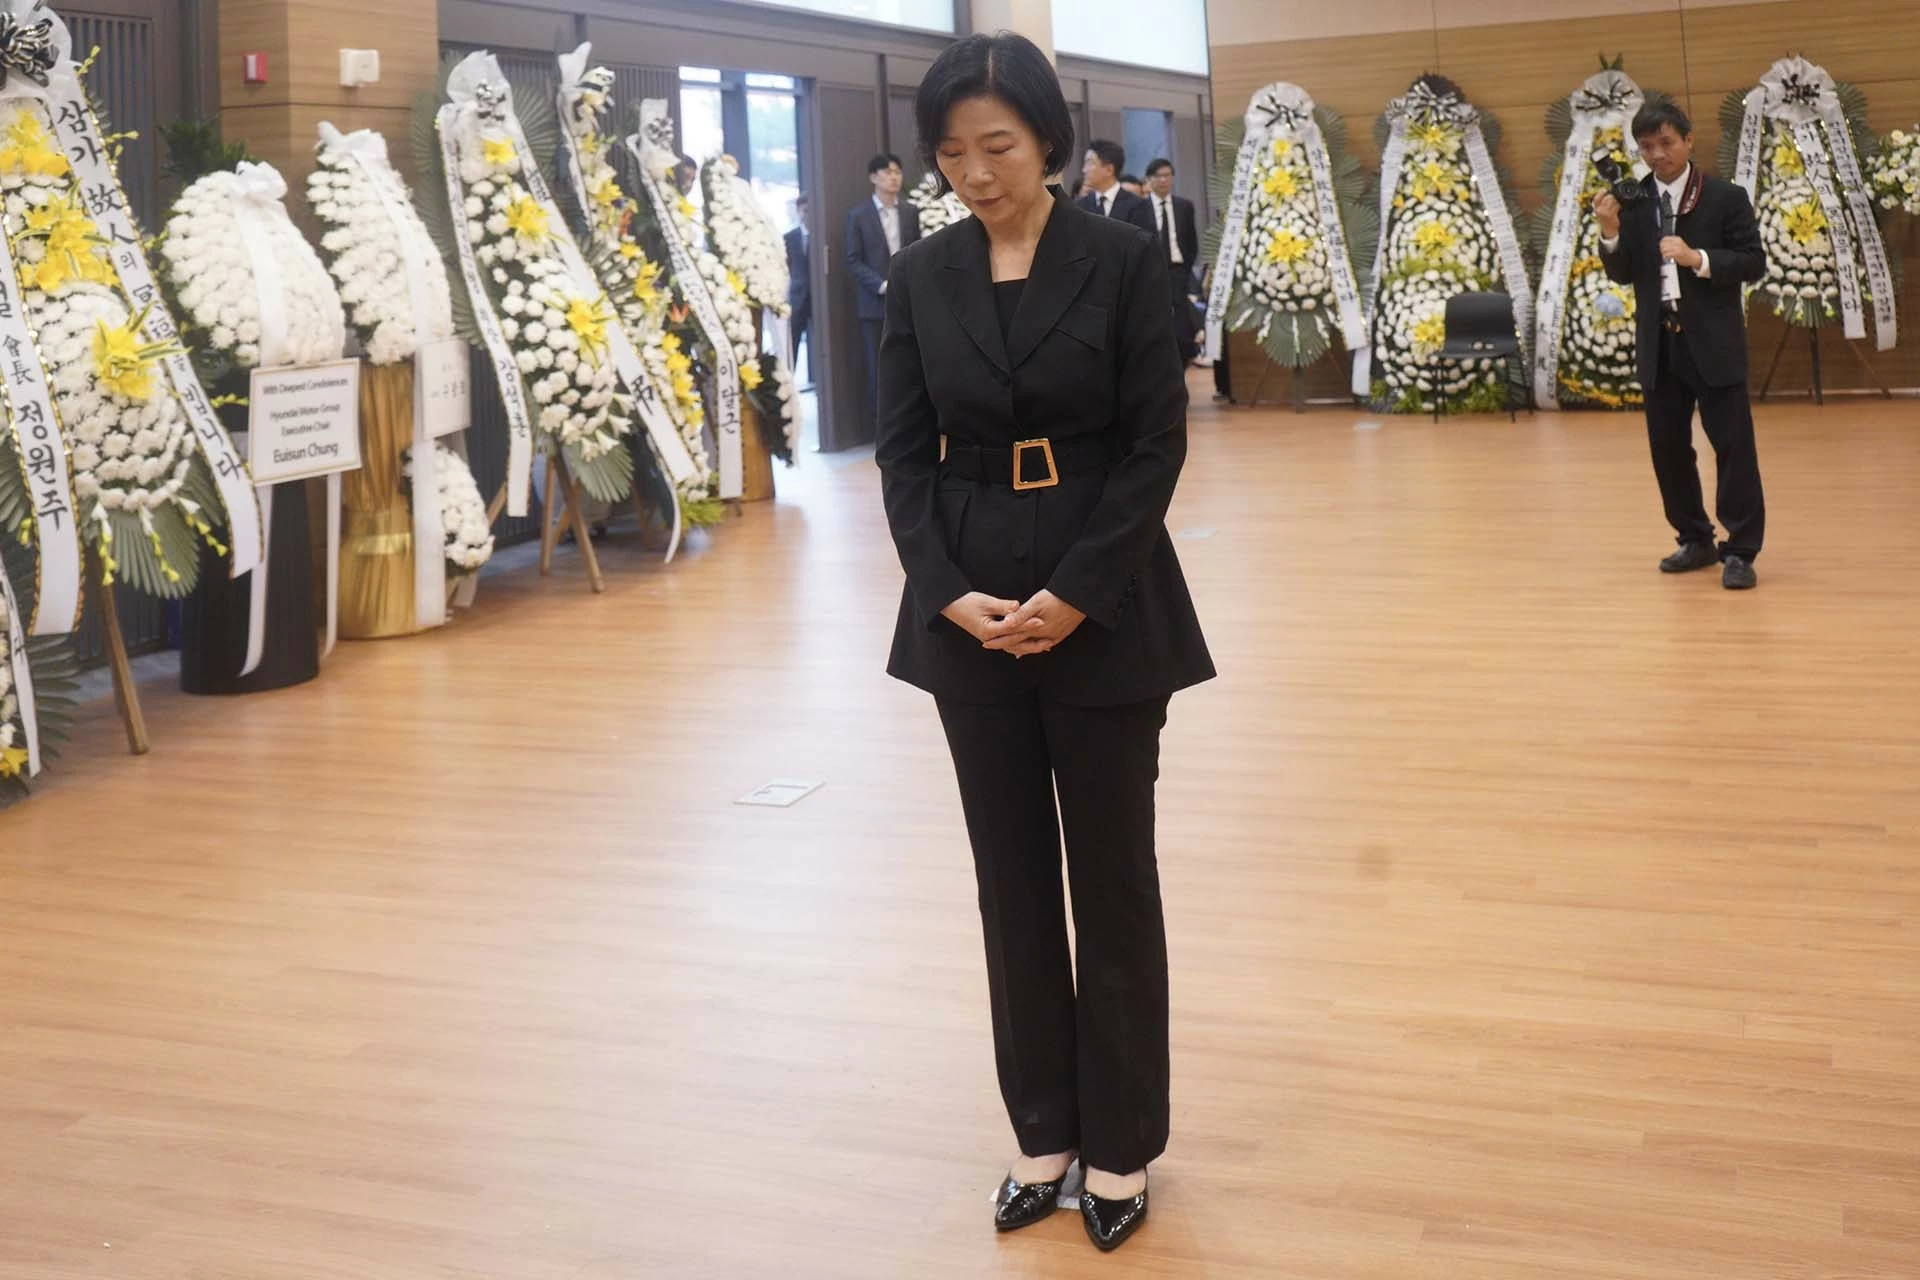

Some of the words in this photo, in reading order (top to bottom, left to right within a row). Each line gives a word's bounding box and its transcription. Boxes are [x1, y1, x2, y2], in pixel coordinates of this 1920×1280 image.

[57, 100, 104, 167] 삼가
[87, 183, 138, 270] 故人의
[183, 383, 242, 481] 빕니다
[3, 334, 35, 385] 會長
[17, 400, 68, 531] 정원주
[273, 448, 306, 464] Euisun
[307, 442, 339, 458] Chung
